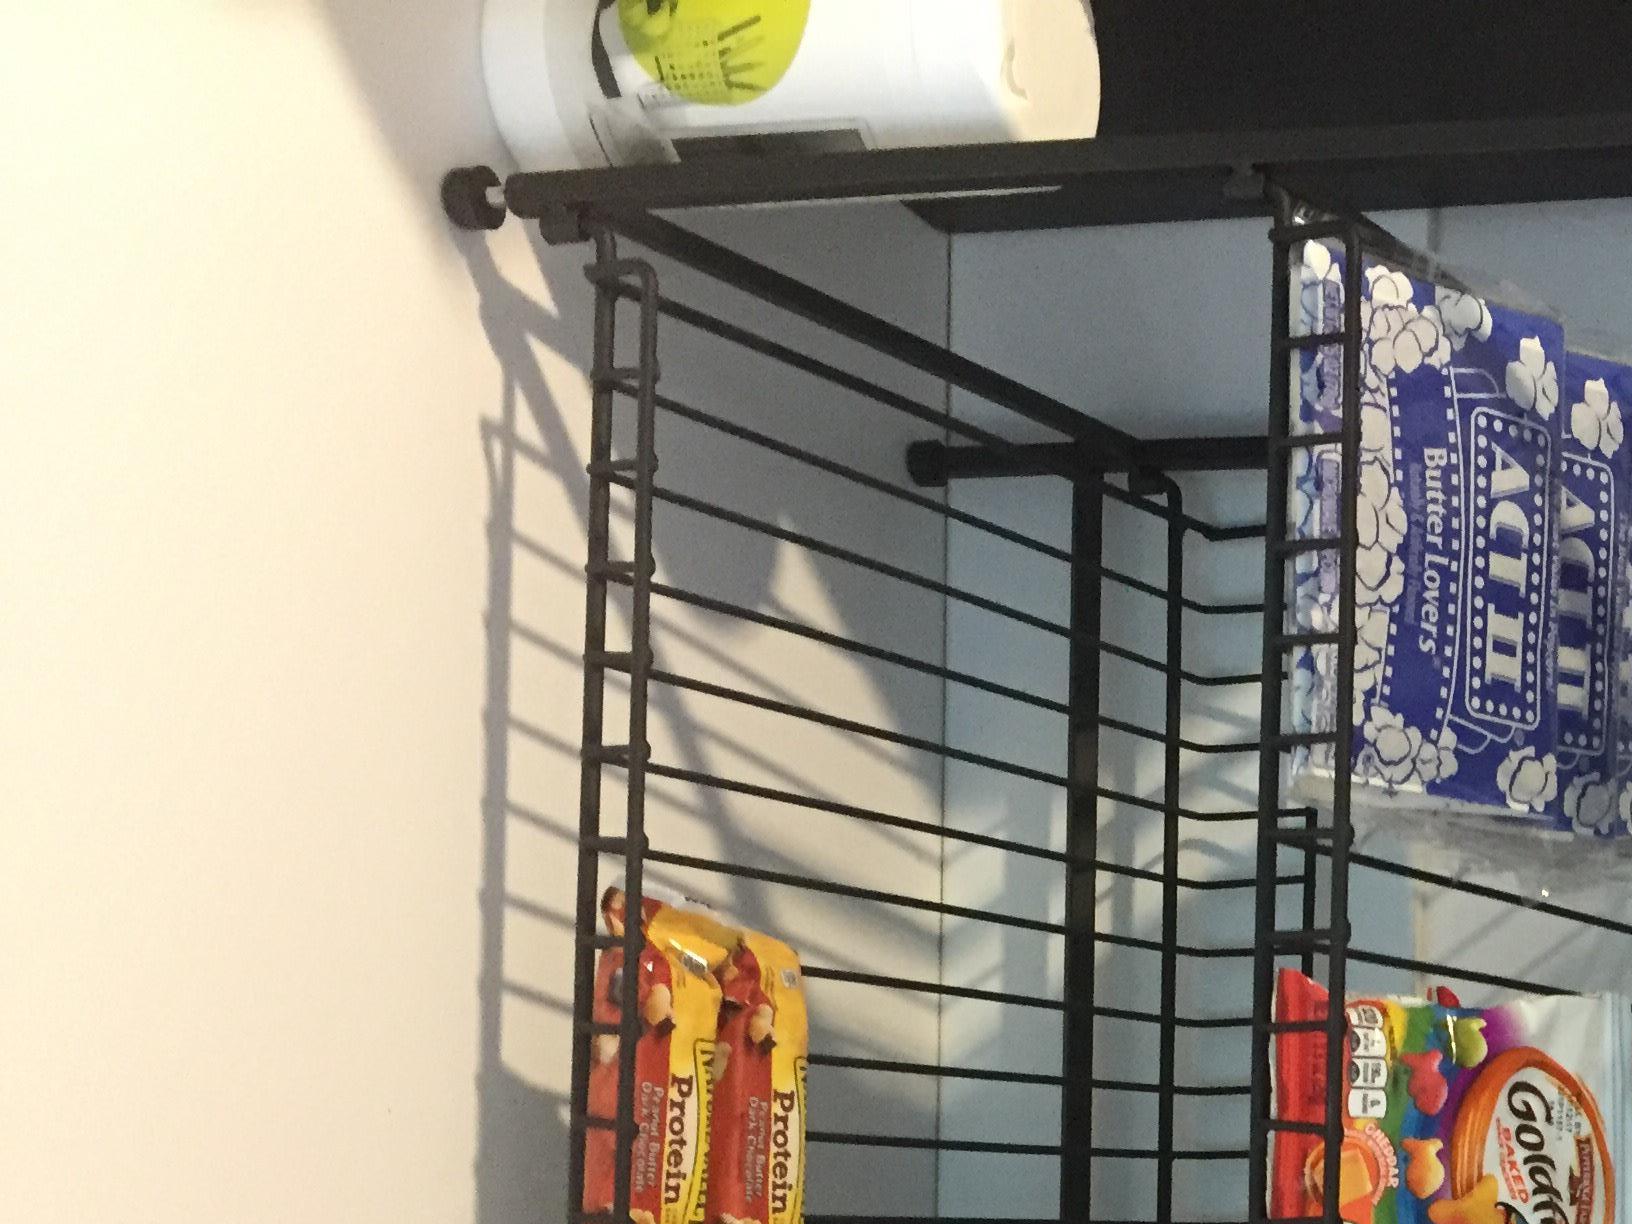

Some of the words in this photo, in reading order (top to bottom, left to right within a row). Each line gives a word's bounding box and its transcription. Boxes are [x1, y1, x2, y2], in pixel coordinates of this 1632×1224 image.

[1423, 447, 1449, 550] Butter
[1485, 440, 1531, 598] ACT
[1558, 485, 1596, 631] ACT
[1418, 552, 1450, 655] Lovers
[1484, 603, 1527, 693] II
[640, 1081, 653, 1117] Dark
[651, 1086, 664, 1137] Peanut
[664, 1073, 694, 1206] Protein
[747, 1096, 759, 1130] Dark
[646, 1141, 661, 1187] Butter
[754, 1154, 766, 1198] Butter
[771, 1089, 796, 1214] Protein
[1364, 1124, 1400, 1189] CHEDDAR
[1503, 1127, 1530, 1204] BAKED
